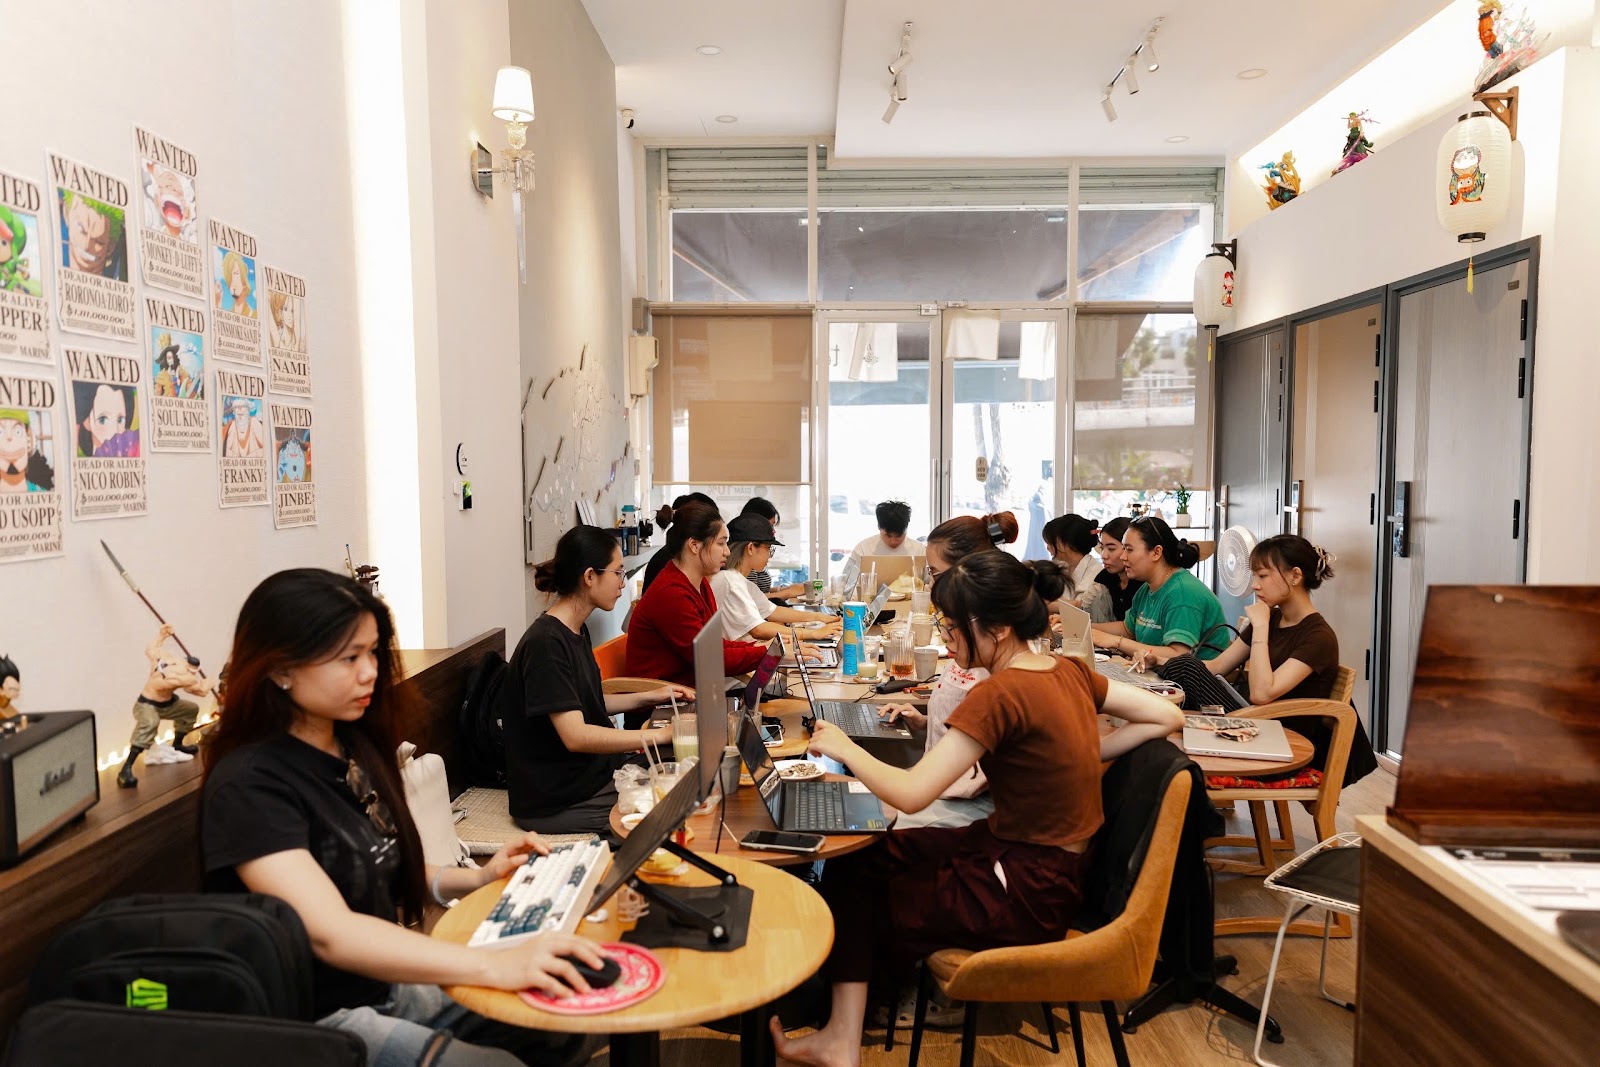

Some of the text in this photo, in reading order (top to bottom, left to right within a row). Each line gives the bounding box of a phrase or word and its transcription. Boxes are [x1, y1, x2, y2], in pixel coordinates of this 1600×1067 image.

[136, 127, 197, 178] WANTED
[50, 154, 128, 207] WANTED
[0, 172, 40, 211] TED
[145, 229, 198, 255] DEAD OR ALIVE
[209, 219, 257, 258] WANTED
[63, 269, 129, 294] DEAD OR ALIVE
[264, 266, 306, 298] WANTED
[11, 294, 44, 310] ALIVE
[0, 305, 43, 332] PPER
[146, 298, 205, 334] WANTED
[216, 309, 232, 320] DEAD
[241, 316, 258, 328] ALIVE
[271, 348, 284, 358] DEAD
[292, 352, 306, 361] ALIVE
[65, 350, 141, 384] WANTED
[272, 357, 308, 377] NAMI
[0, 375, 55, 408] NTED
[218, 371, 265, 397] WANTED
[154, 397, 205, 410] DEAD OR ALIVE
[157, 408, 205, 428] SOUL KING
[271, 405, 312, 427] WANTED
[78, 459, 141, 470] DEAD OR ALIVE
[222, 458, 264, 467] DEAD OR ALIVE
[79, 471, 141, 491] NICO ROBIN
[223, 468, 264, 484] FRANKY
[277, 483, 312, 492] DEAD OR ALIVE
[6, 495, 21, 506] OR
[25, 493, 56, 505] ALIVE
[279, 491, 312, 508] JINBE
[12, 506, 55, 529] USOPP
[32, 541, 63, 553] MARINE
